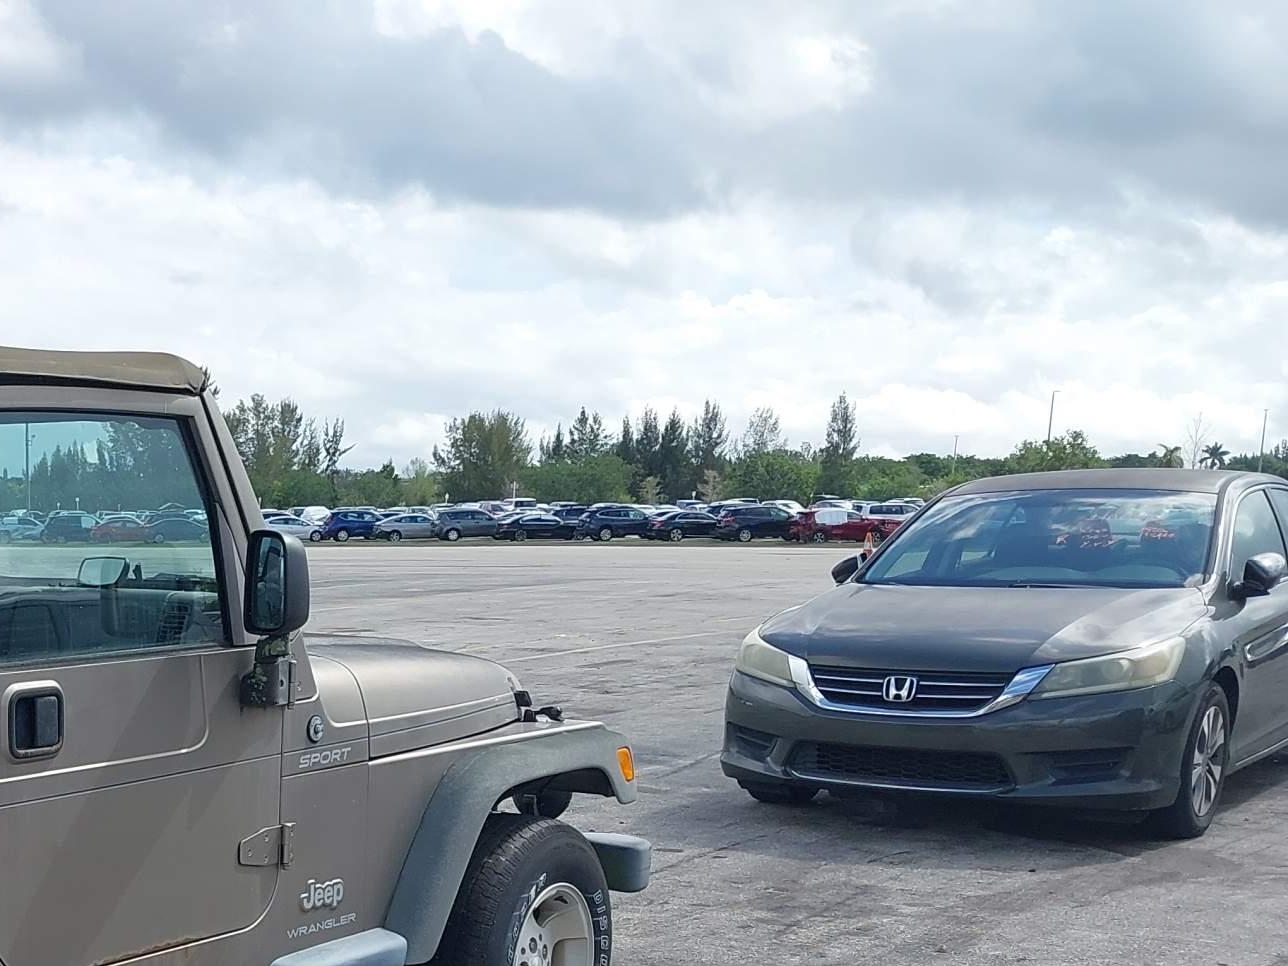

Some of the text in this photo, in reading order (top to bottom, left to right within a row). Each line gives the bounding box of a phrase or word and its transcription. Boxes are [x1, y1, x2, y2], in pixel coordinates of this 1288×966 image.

[298, 747, 352, 769] SPORT
[300, 878, 344, 910] Jeep
[286, 912, 357, 939] WRANGLER
